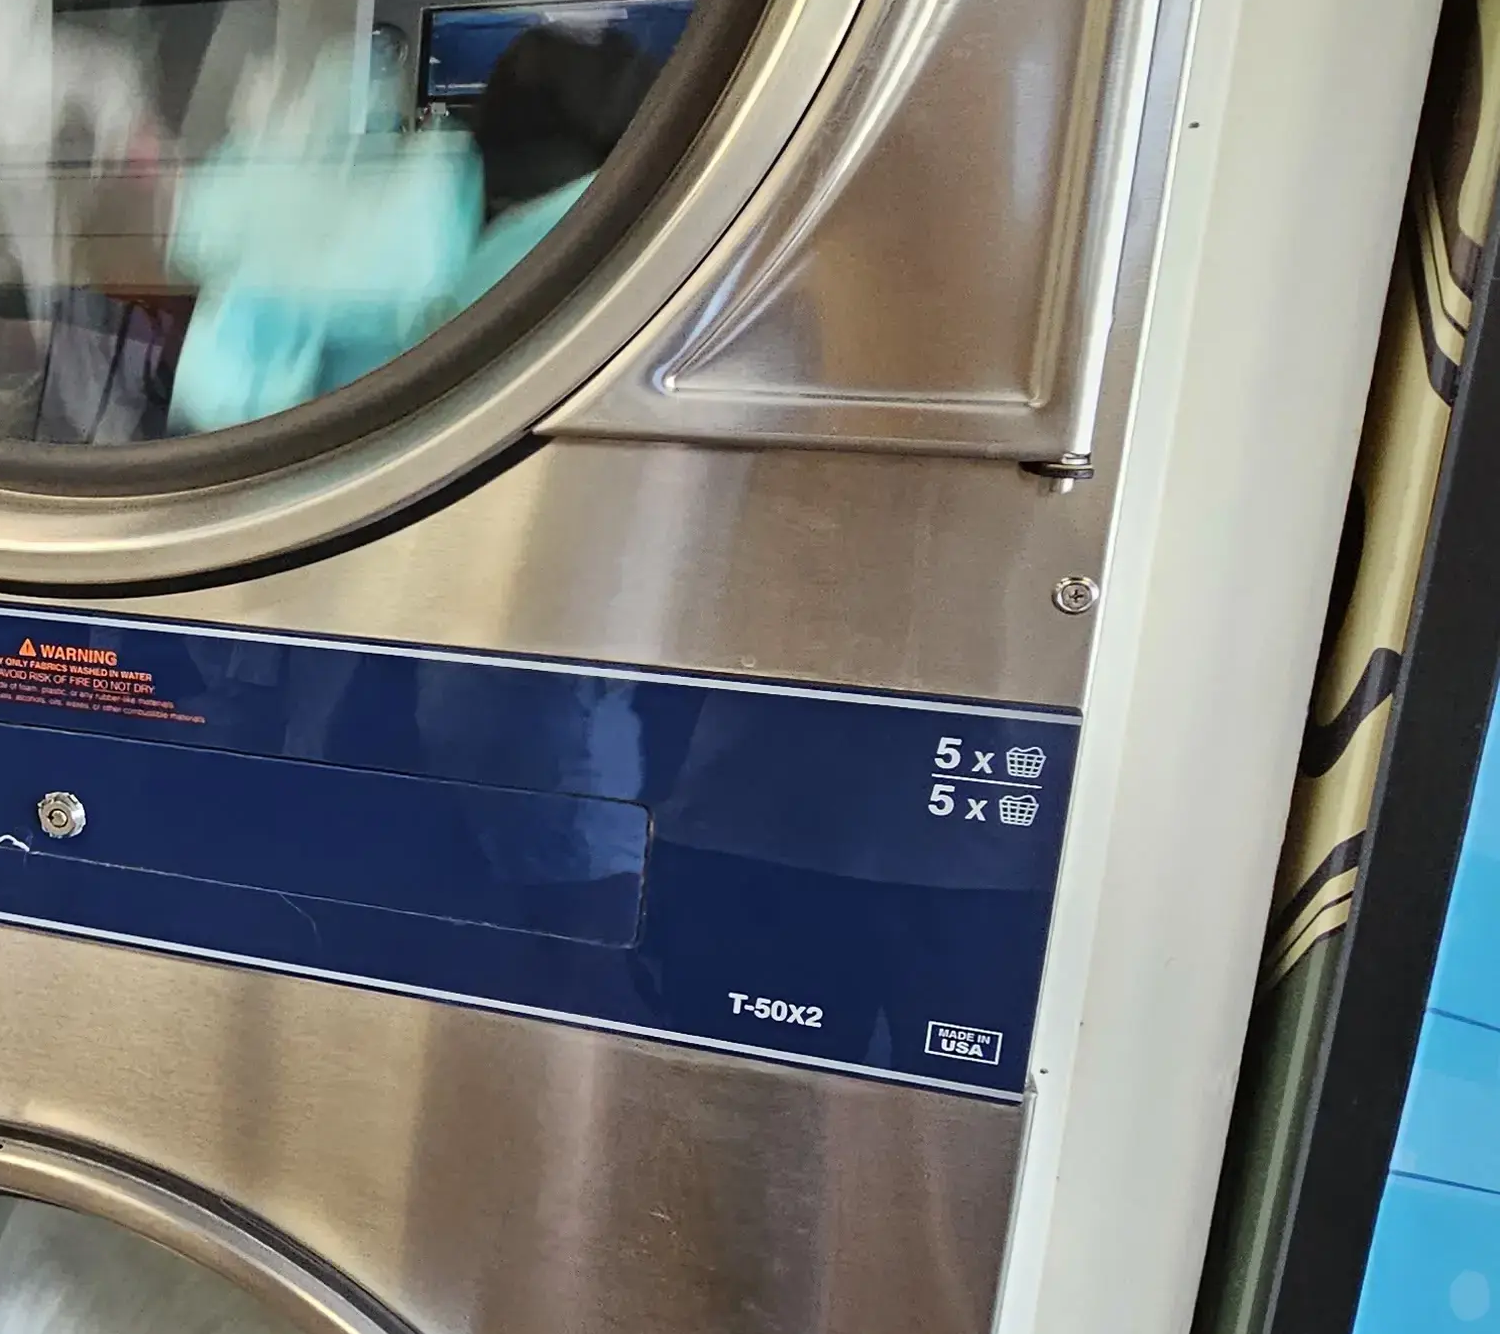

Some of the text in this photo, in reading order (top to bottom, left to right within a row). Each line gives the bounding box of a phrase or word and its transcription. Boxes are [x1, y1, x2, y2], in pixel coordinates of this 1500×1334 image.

[40, 644, 118, 667] WARNING
[5, 657, 28, 668] ONLY
[30, 660, 68, 673] FABRICS
[70, 665, 108, 677] WASHED
[109, 669, 119, 678] IN
[120, 671, 153, 682] WATER
[29, 672, 52, 683] RISK
[53, 674, 67, 684] OF
[69, 676, 91, 687] FIRE
[93, 678, 108, 690] DO
[110, 681, 131, 692] NOT
[933, 736, 995, 774] 5 x
[927, 784, 988, 821] 5 x
[728, 992, 824, 1028] T-50X2
[938, 1028, 991, 1045] MADE IN
[941, 1038, 984, 1057] USA
